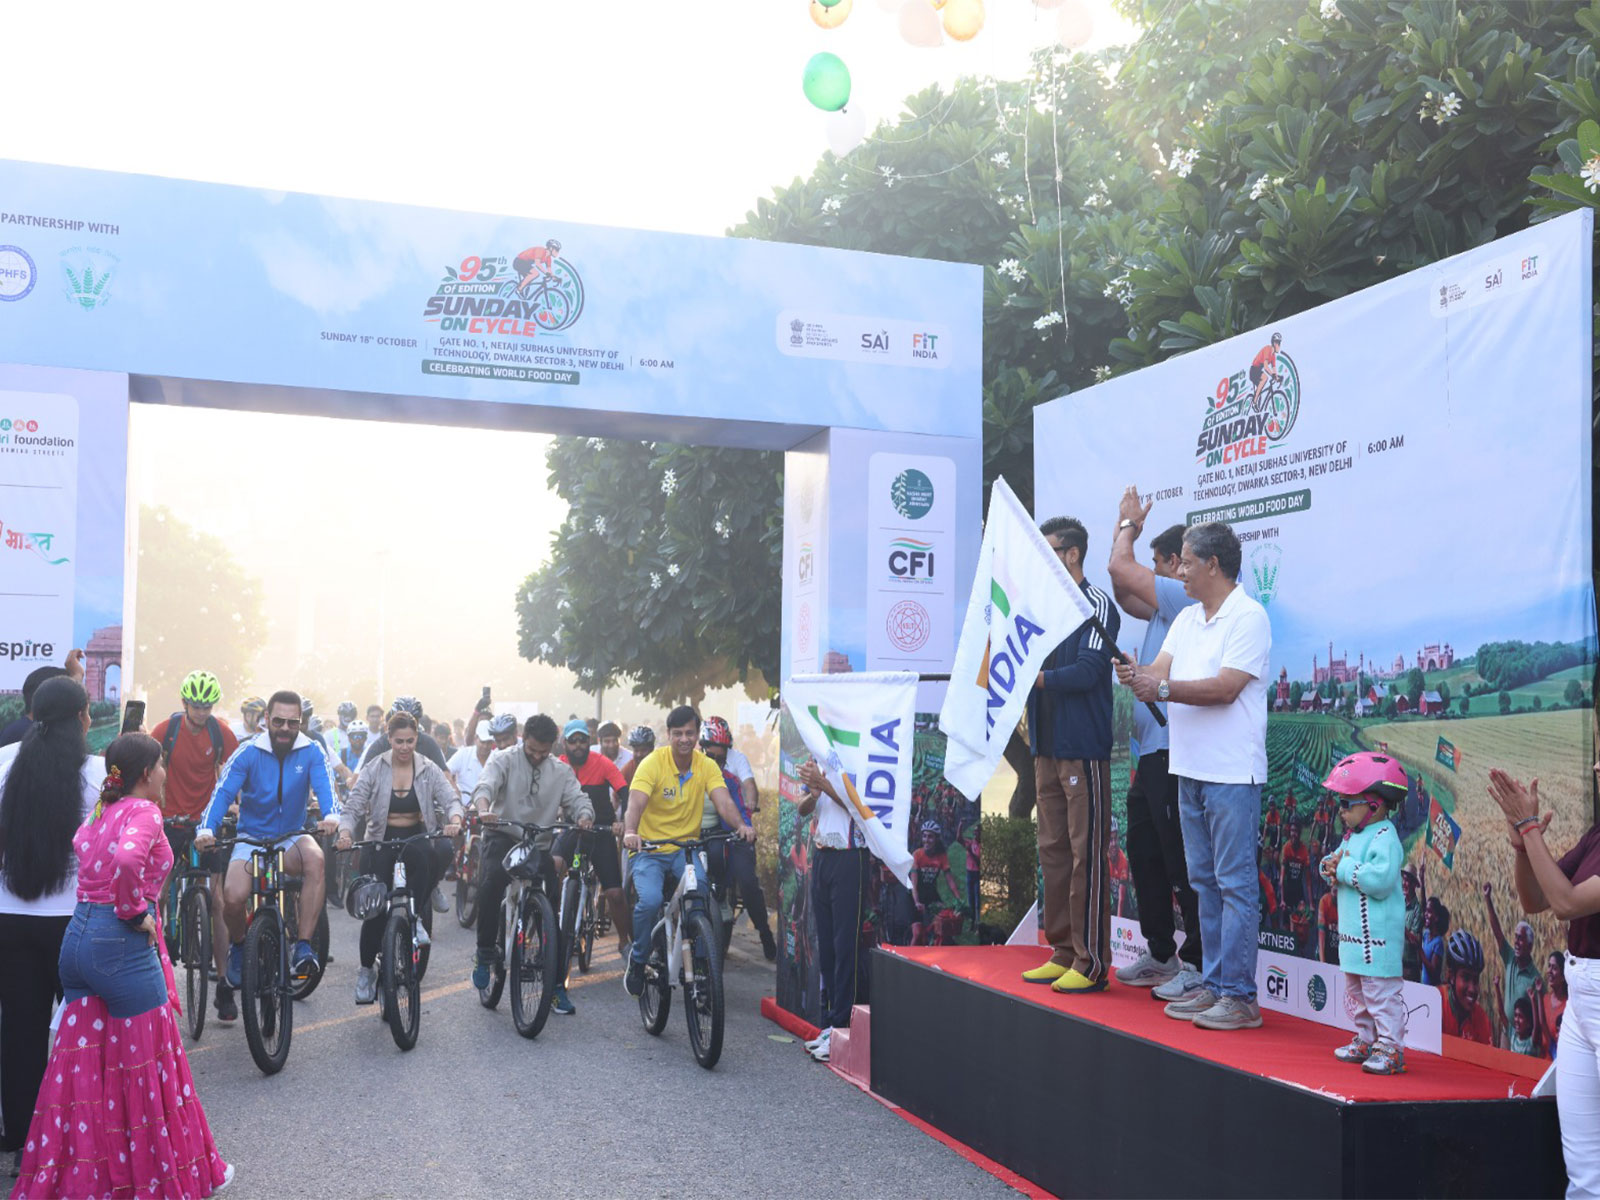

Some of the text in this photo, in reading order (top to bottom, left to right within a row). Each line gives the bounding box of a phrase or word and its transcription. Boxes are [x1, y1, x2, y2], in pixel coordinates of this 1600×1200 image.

[1, 213, 120, 235] PARTNERSHIP WITH
[1521, 269, 1538, 280] INDIA
[458, 284, 496, 293] EDITION
[423, 296, 541, 320] SUNDAY
[440, 317, 537, 337] ON CYCLE
[320, 331, 357, 343] SUNDAY
[377, 337, 418, 348] OCTOBER
[440, 337, 461, 347] GATE
[463, 338, 479, 348] NO.
[490, 341, 518, 352] NETAJI
[520, 343, 555, 354] SUBHAS
[556, 347, 606, 359] UNIVERSITY
[607, 350, 619, 359] OF
[861, 331, 889, 350] SAI
[433, 347, 624, 371] TECHNOLOGY, DWARKA SECTOR-3, NEW DELHI
[639, 358, 675, 369] 6:00 AM
[912, 350, 938, 360] INDIA
[429, 362, 572, 382] CELEBRATING WORLD FOOD DAY
[1196, 412, 1269, 457] SUNDAY
[1367, 435, 1404, 454] 6:00 AM
[1206, 435, 1267, 468] ON CYCLE
[1197, 472, 1213, 488] GATE
[1215, 470, 1227, 481] NO.
[1235, 462, 1258, 477] NETAJI
[1259, 455, 1288, 472] SUBHAS
[1289, 443, 1335, 464] UNIVERSITY
[1336, 440, 1347, 453] OF
[1193, 456, 1352, 502] TECHNOLOGY, DWARKA SECTOR-3, NEW DELHI
[1156, 486, 1183, 501] OCTOBER
[1191, 494, 1304, 525] CELEBRATING WORLD FOOD DAY
[1239, 527, 1279, 542] ERSHIP WITH
[799, 553, 814, 579] CFI
[888, 550, 934, 577] CFI
[986, 614, 1046, 742] NDIA
[864, 718, 901, 829] NDIA
[1257, 931, 1295, 952] ARTNERS
[1267, 975, 1288, 998] CFI
